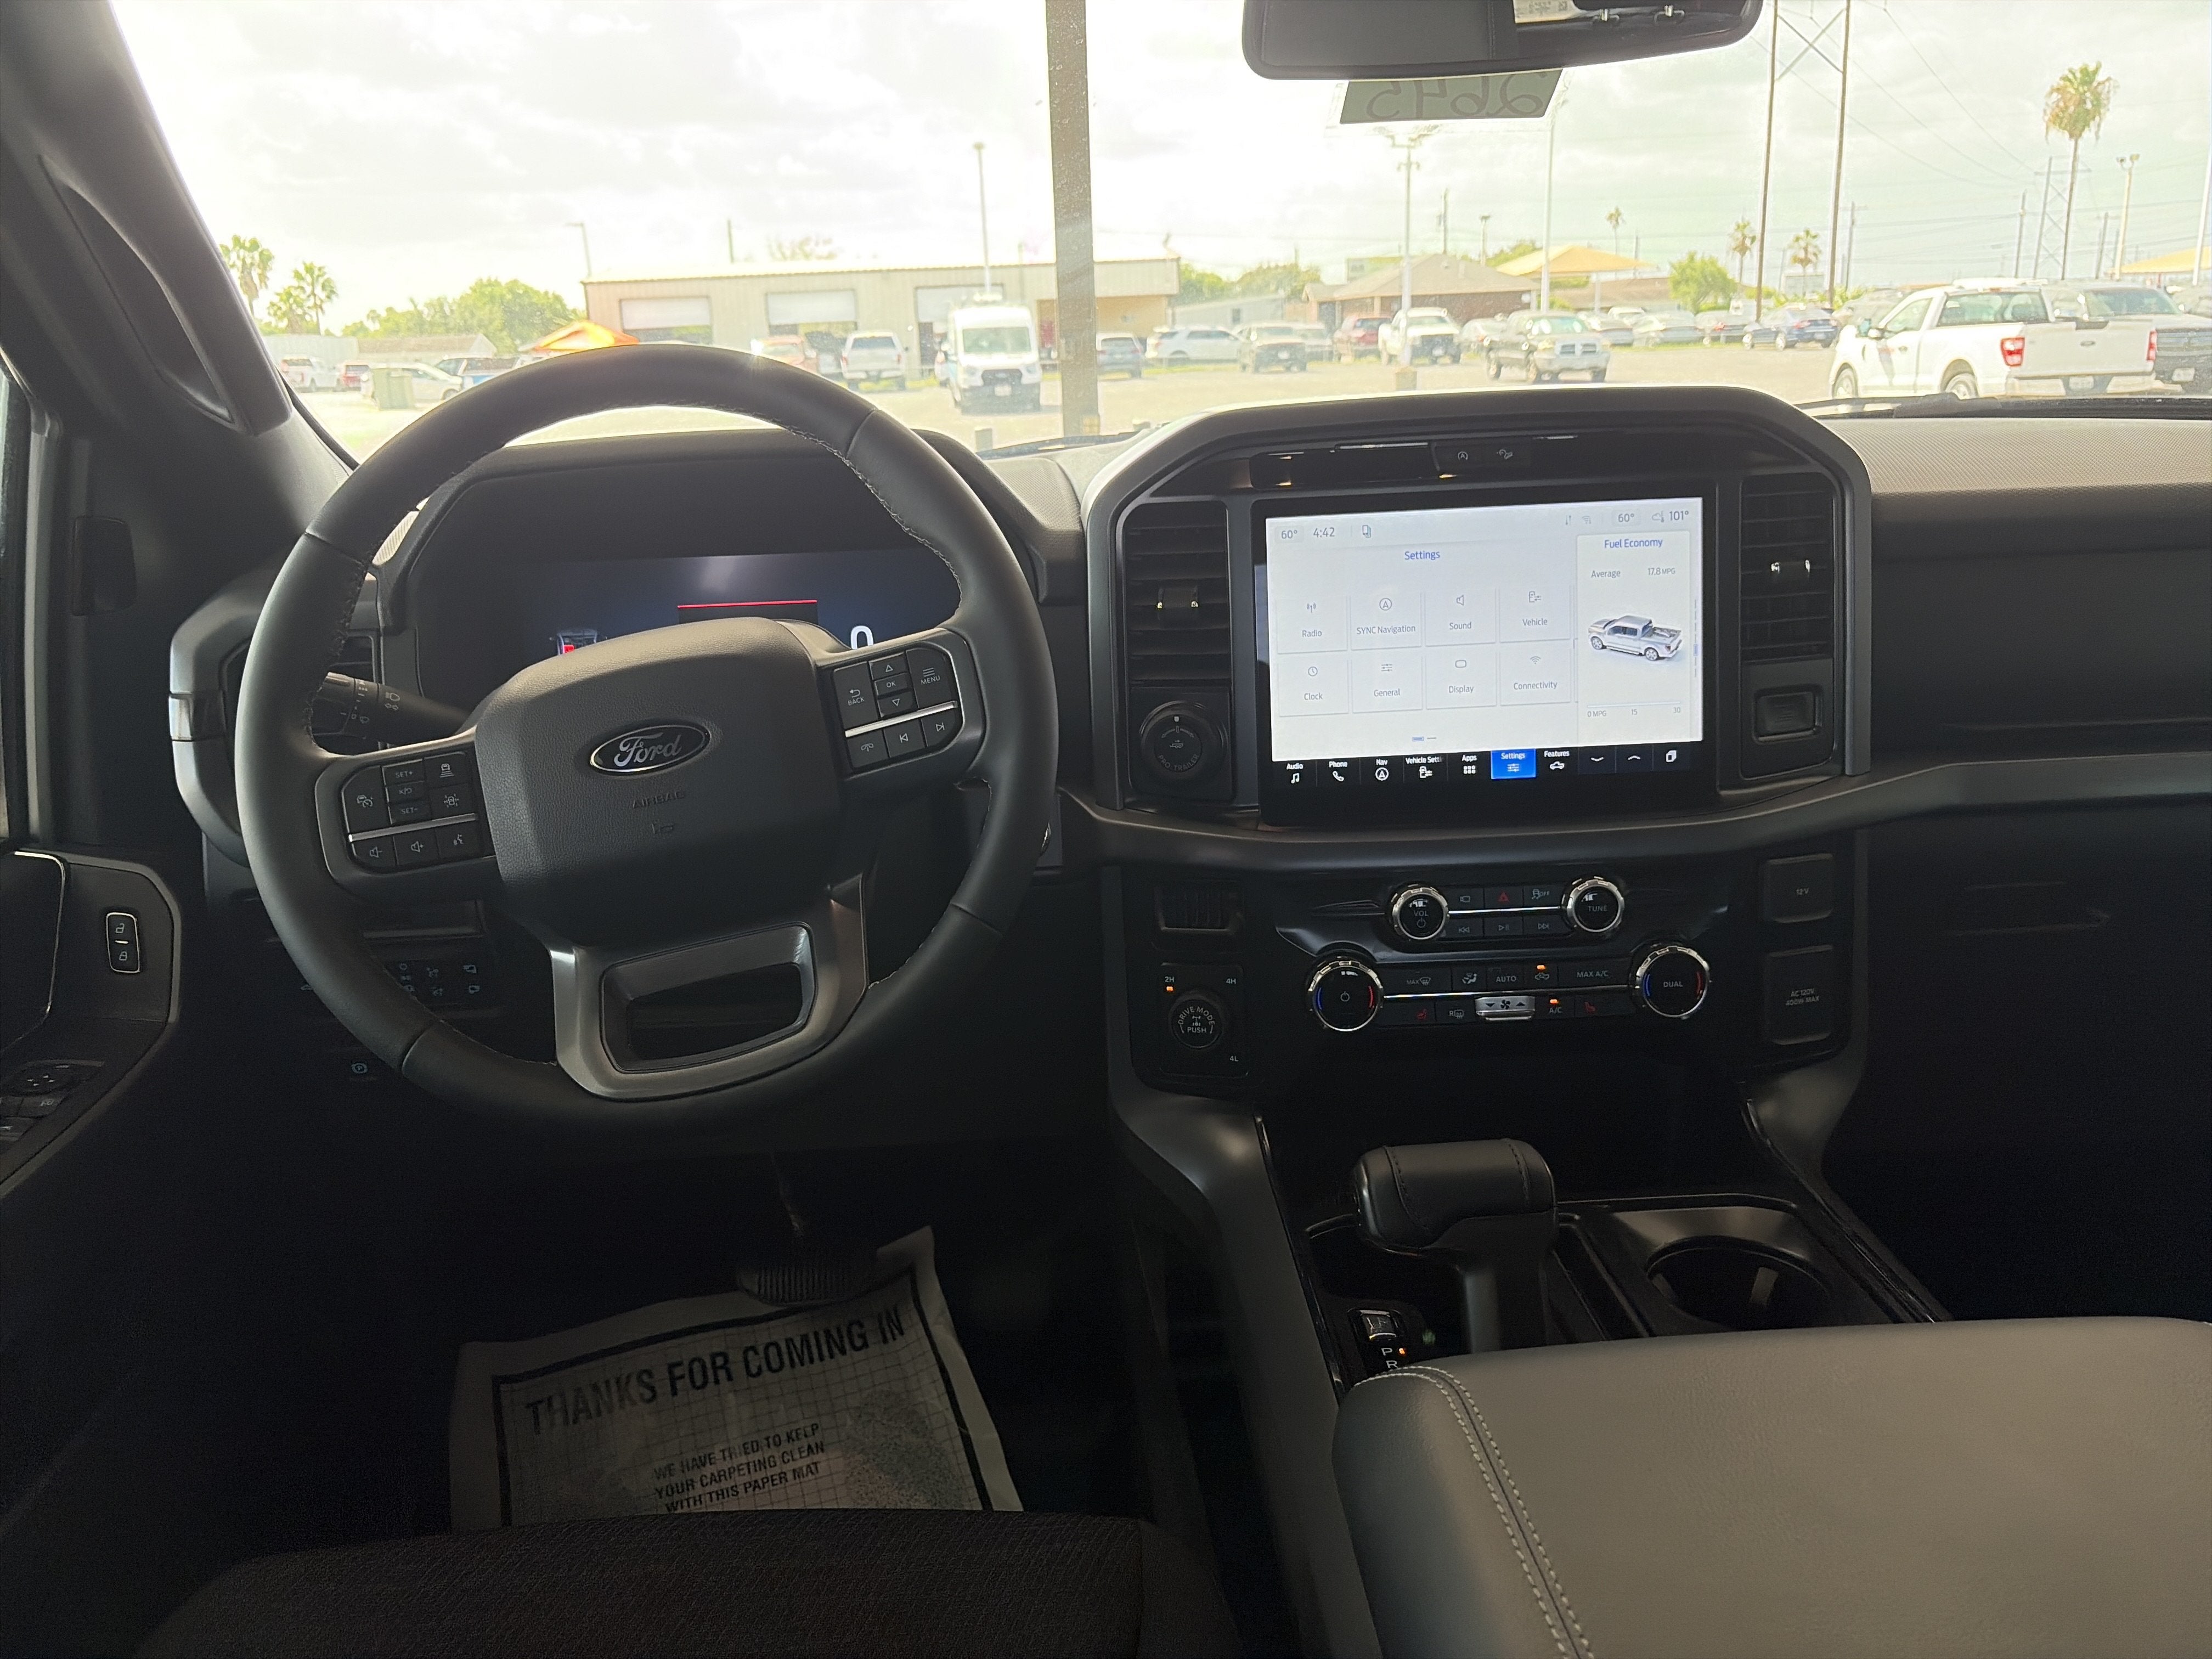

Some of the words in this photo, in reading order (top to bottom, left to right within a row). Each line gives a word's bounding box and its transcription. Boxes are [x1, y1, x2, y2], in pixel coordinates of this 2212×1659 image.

[1313, 527, 1335, 538] 4:42
[1604, 540, 1622, 549] Fuel
[1624, 538, 1663, 549] Economy
[1404, 550, 1440, 561] Settings
[1591, 569, 1621, 578] Average
[1449, 622, 1471, 630] Sound
[1522, 618, 1548, 627] Vehicle
[1356, 627, 1376, 635] SYNC
[1378, 625, 1415, 634] Navigation
[921, 675, 940, 685] MENU
[1448, 685, 1474, 694] Display
[1514, 681, 1558, 690] Connectivity
[1304, 692, 1323, 701] Clock
[1374, 689, 1400, 697] General
[848, 697, 865, 706] BACK
[614, 732, 682, 767] Ford
[1544, 749, 1570, 758] Features
[1158, 754, 1171, 768] PRO
[1174, 754, 1199, 771] TRAILER
[1178, 1006, 1195, 1025] DRIVE
[1197, 1006, 1215, 1026] MODE
[1381, 1347, 1393, 1356] P
[1386, 1360, 1398, 1369] R
[526, 1369, 657, 1436] THANKS
[668, 1352, 733, 1396] FOR
[743, 1319, 869, 1378] COMING
[878, 1304, 904, 1344] IN
[653, 1463, 675, 1480] WE
[680, 1452, 716, 1473] HAVE
[764, 1434, 781, 1449] TO
[654, 1478, 695, 1499] YOUR
[699, 1455, 777, 1488] CARPETING
[782, 1441, 825, 1464] CLEAN
[665, 1494, 702, 1513] WITH
[707, 1485, 740, 1503] THIS
[743, 1471, 788, 1494] PAPER
[793, 1462, 820, 1481] MAT
